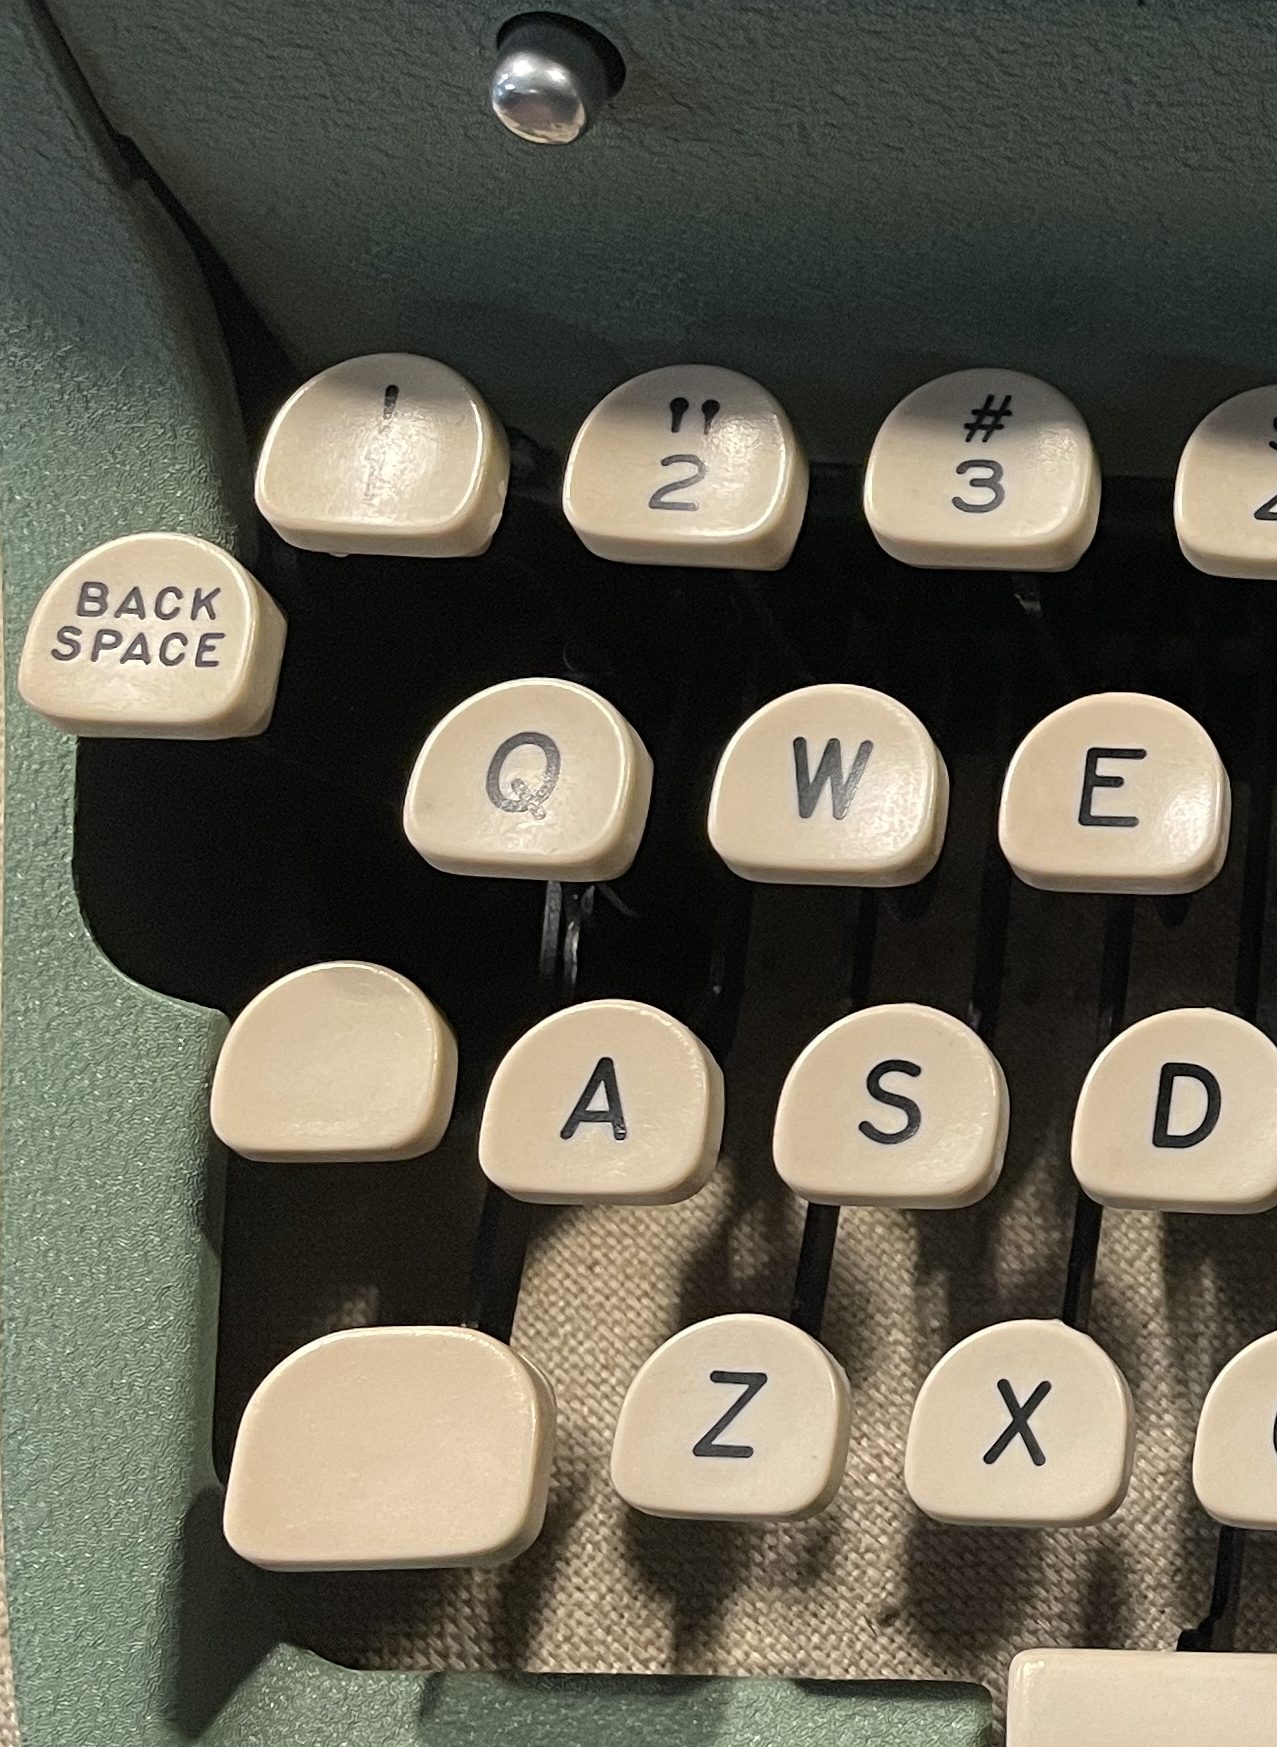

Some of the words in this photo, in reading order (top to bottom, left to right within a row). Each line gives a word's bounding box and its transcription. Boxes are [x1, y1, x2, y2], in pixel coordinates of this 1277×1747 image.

[963, 394, 1013, 443] #
[649, 454, 706, 511] 2
[952, 459, 1005, 513] 3
[76, 581, 221, 621] BACK
[51, 626, 225, 667] SPACE
[486, 732, 560, 821] Q
[793, 737, 873, 820] W
[1078, 747, 1147, 828] E
[560, 1057, 627, 1141] A
[858, 1059, 922, 1145] S
[1152, 1062, 1221, 1149] D
[692, 1370, 768, 1458] Z
[983, 1379, 1052, 1466] X
